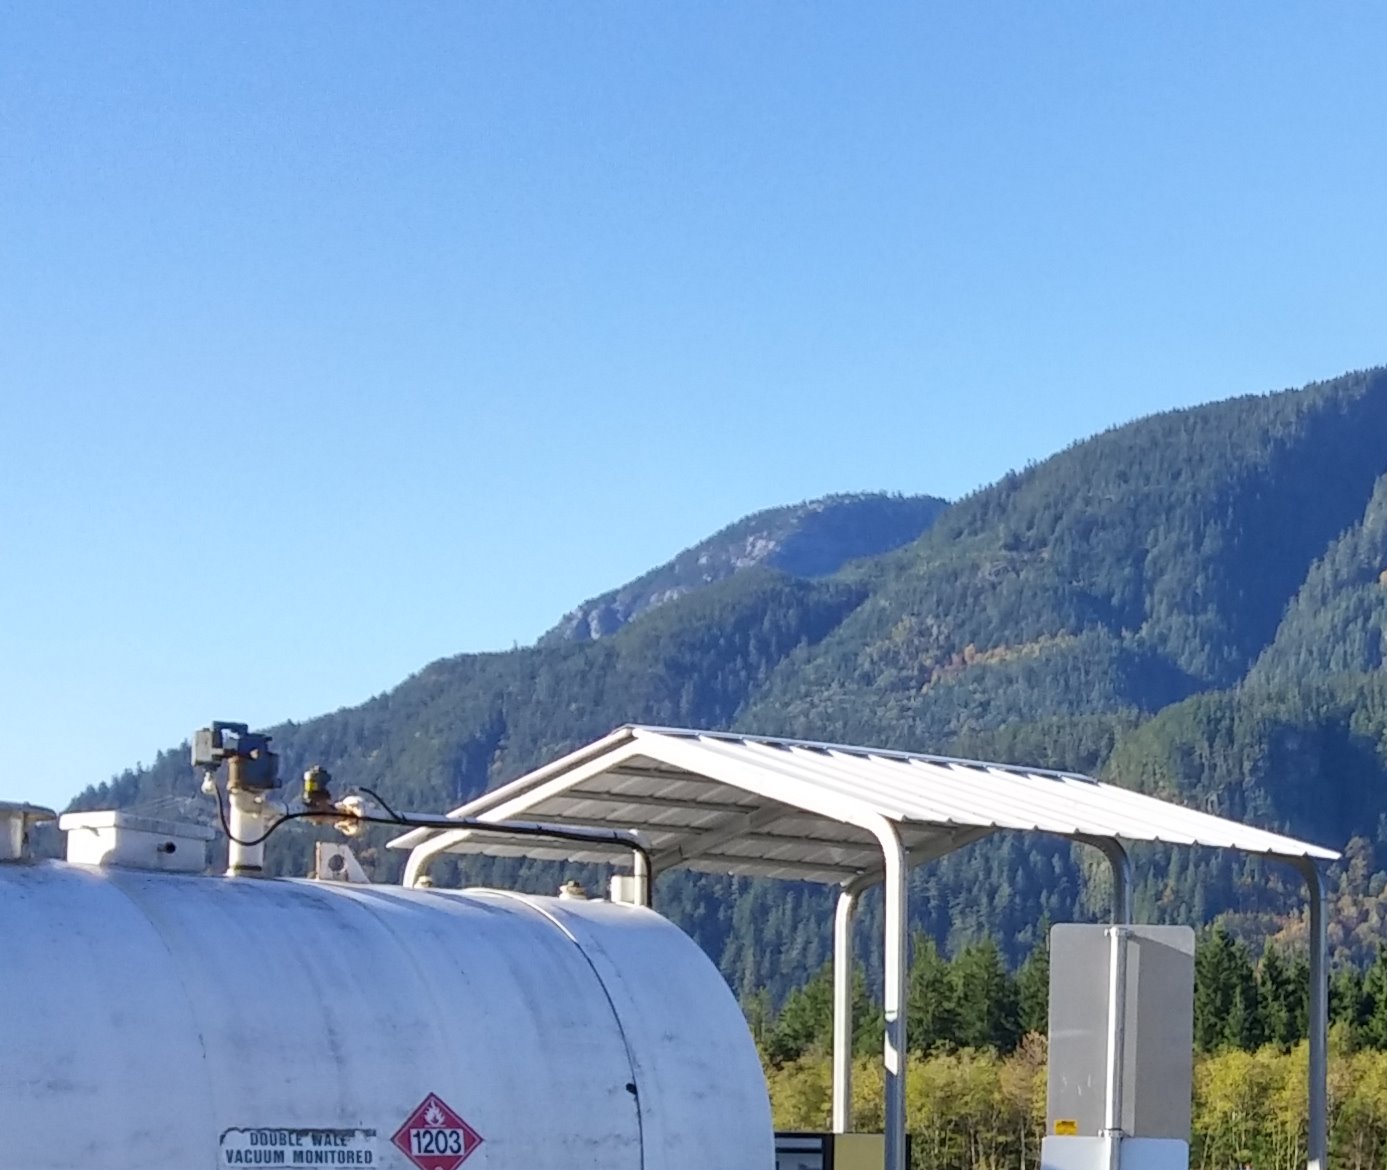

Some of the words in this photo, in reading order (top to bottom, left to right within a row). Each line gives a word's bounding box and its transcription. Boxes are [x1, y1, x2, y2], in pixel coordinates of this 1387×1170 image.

[250, 1131, 303, 1147] DOUBLE
[412, 1130, 462, 1154] 1203
[225, 1149, 285, 1164] VACUUM
[292, 1149, 373, 1164] MONITORED
